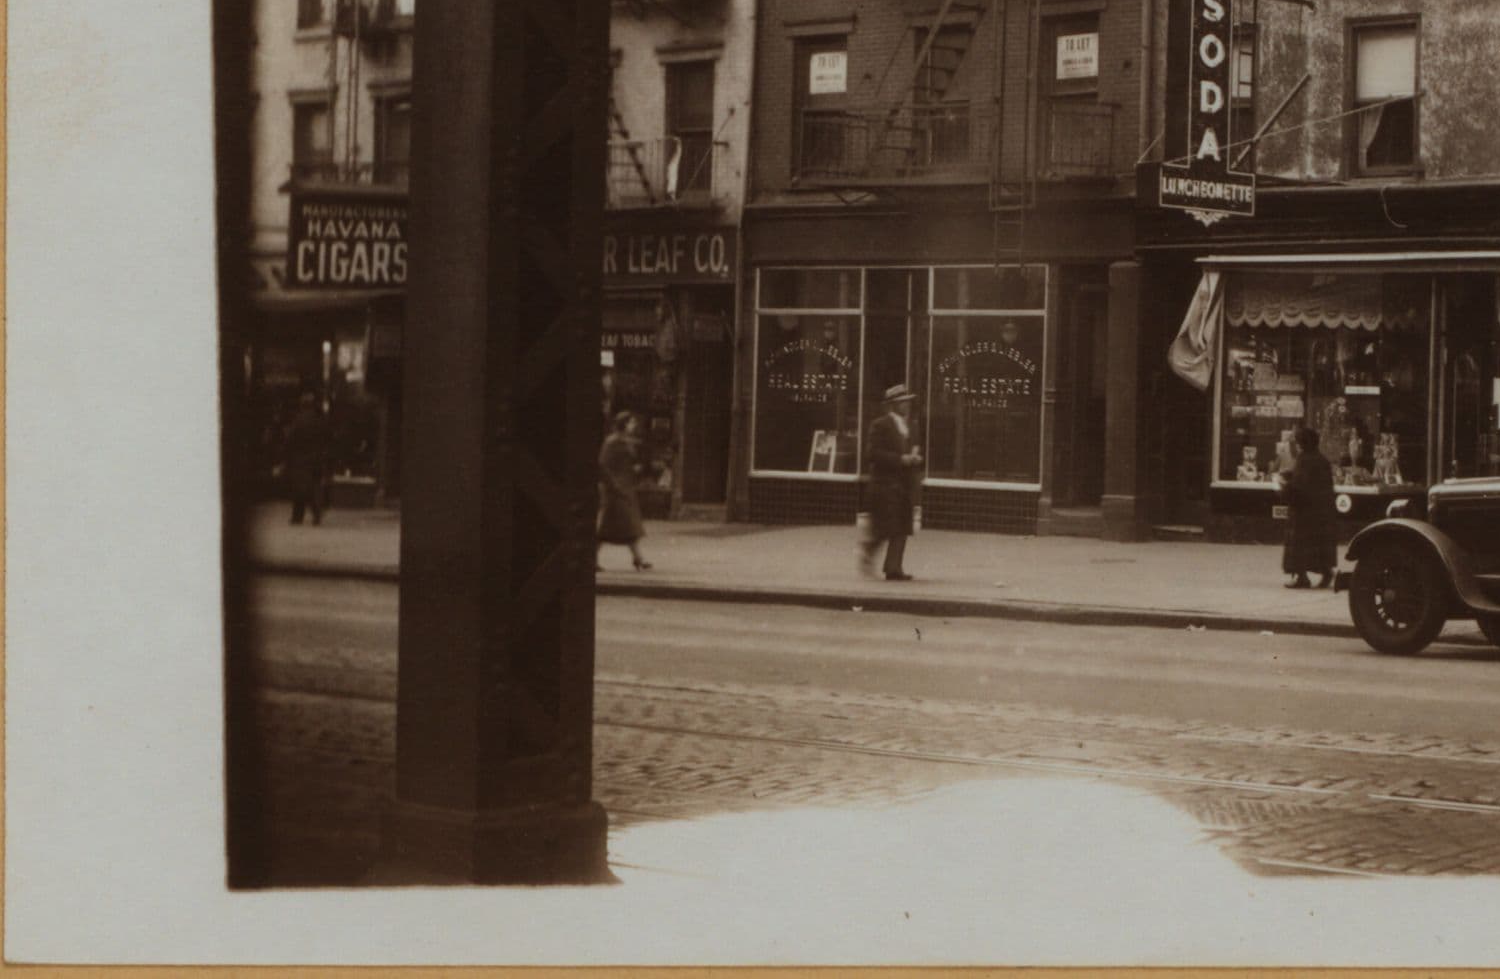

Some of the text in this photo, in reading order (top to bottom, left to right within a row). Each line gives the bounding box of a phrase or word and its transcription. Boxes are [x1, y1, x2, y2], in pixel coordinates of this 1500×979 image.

[1162, 175, 1253, 203] LUNCHEONETTE
[307, 219, 402, 239] HAVANA
[297, 240, 409, 284] CIGARS
[628, 235, 686, 275] LEAF
[768, 373, 848, 391] REAL ESTATE
[944, 376, 1031, 396] REAL ESTATE
